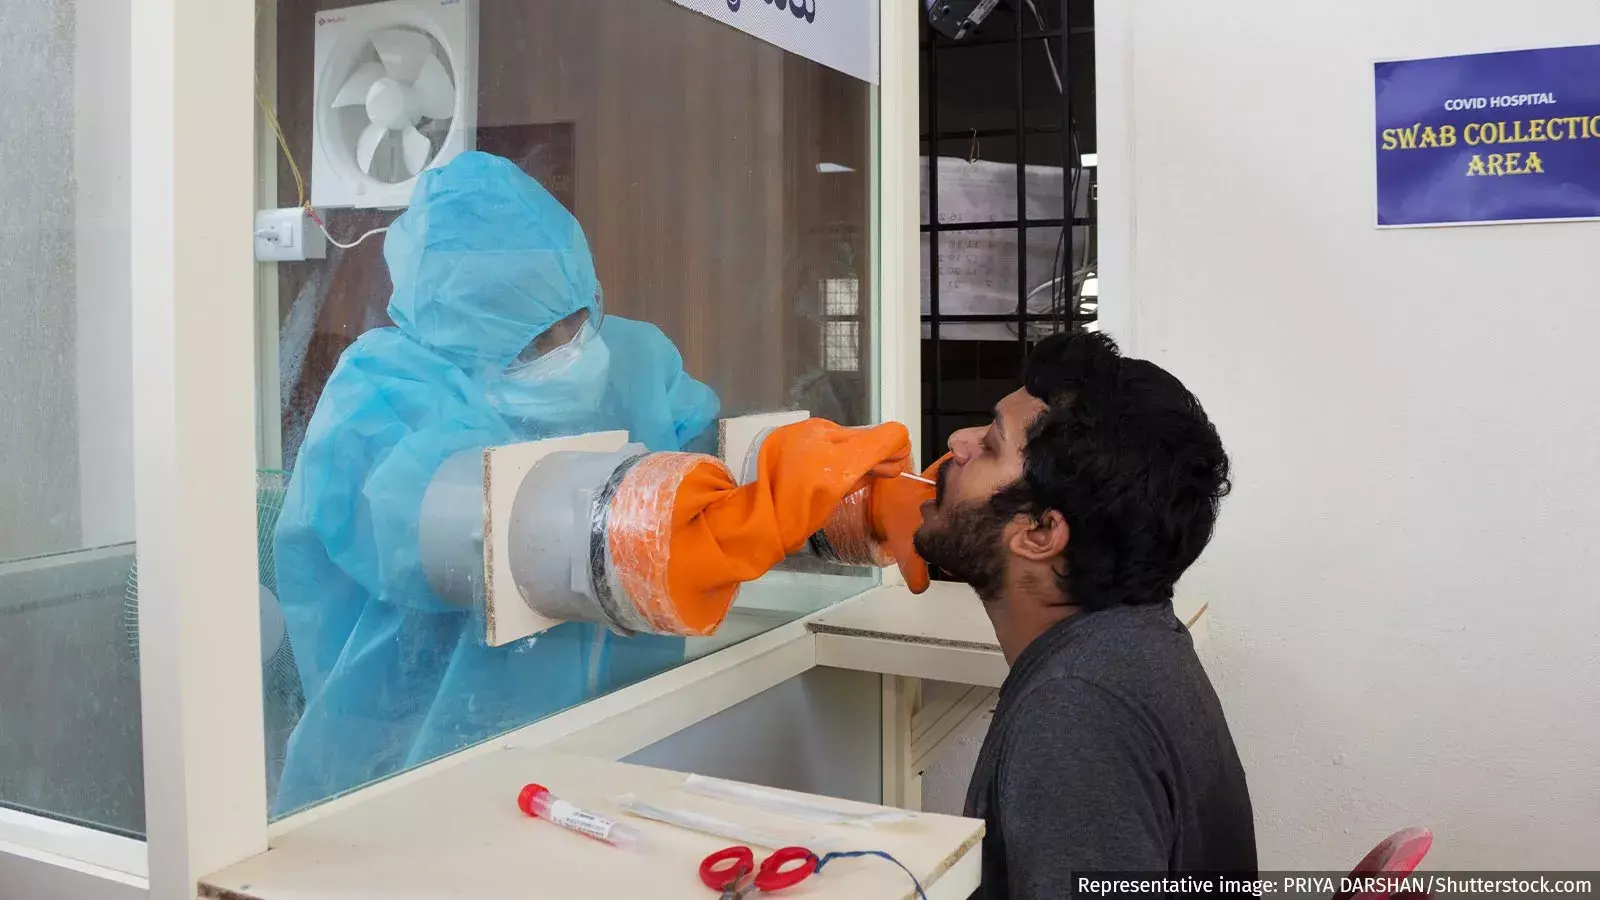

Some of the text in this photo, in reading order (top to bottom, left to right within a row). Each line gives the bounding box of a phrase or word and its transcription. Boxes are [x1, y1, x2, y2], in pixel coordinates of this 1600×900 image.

[1444, 92, 1557, 111] COVID HOSPITAL
[1381, 122, 1457, 150] SWAB
[1466, 151, 1544, 176] AREA
